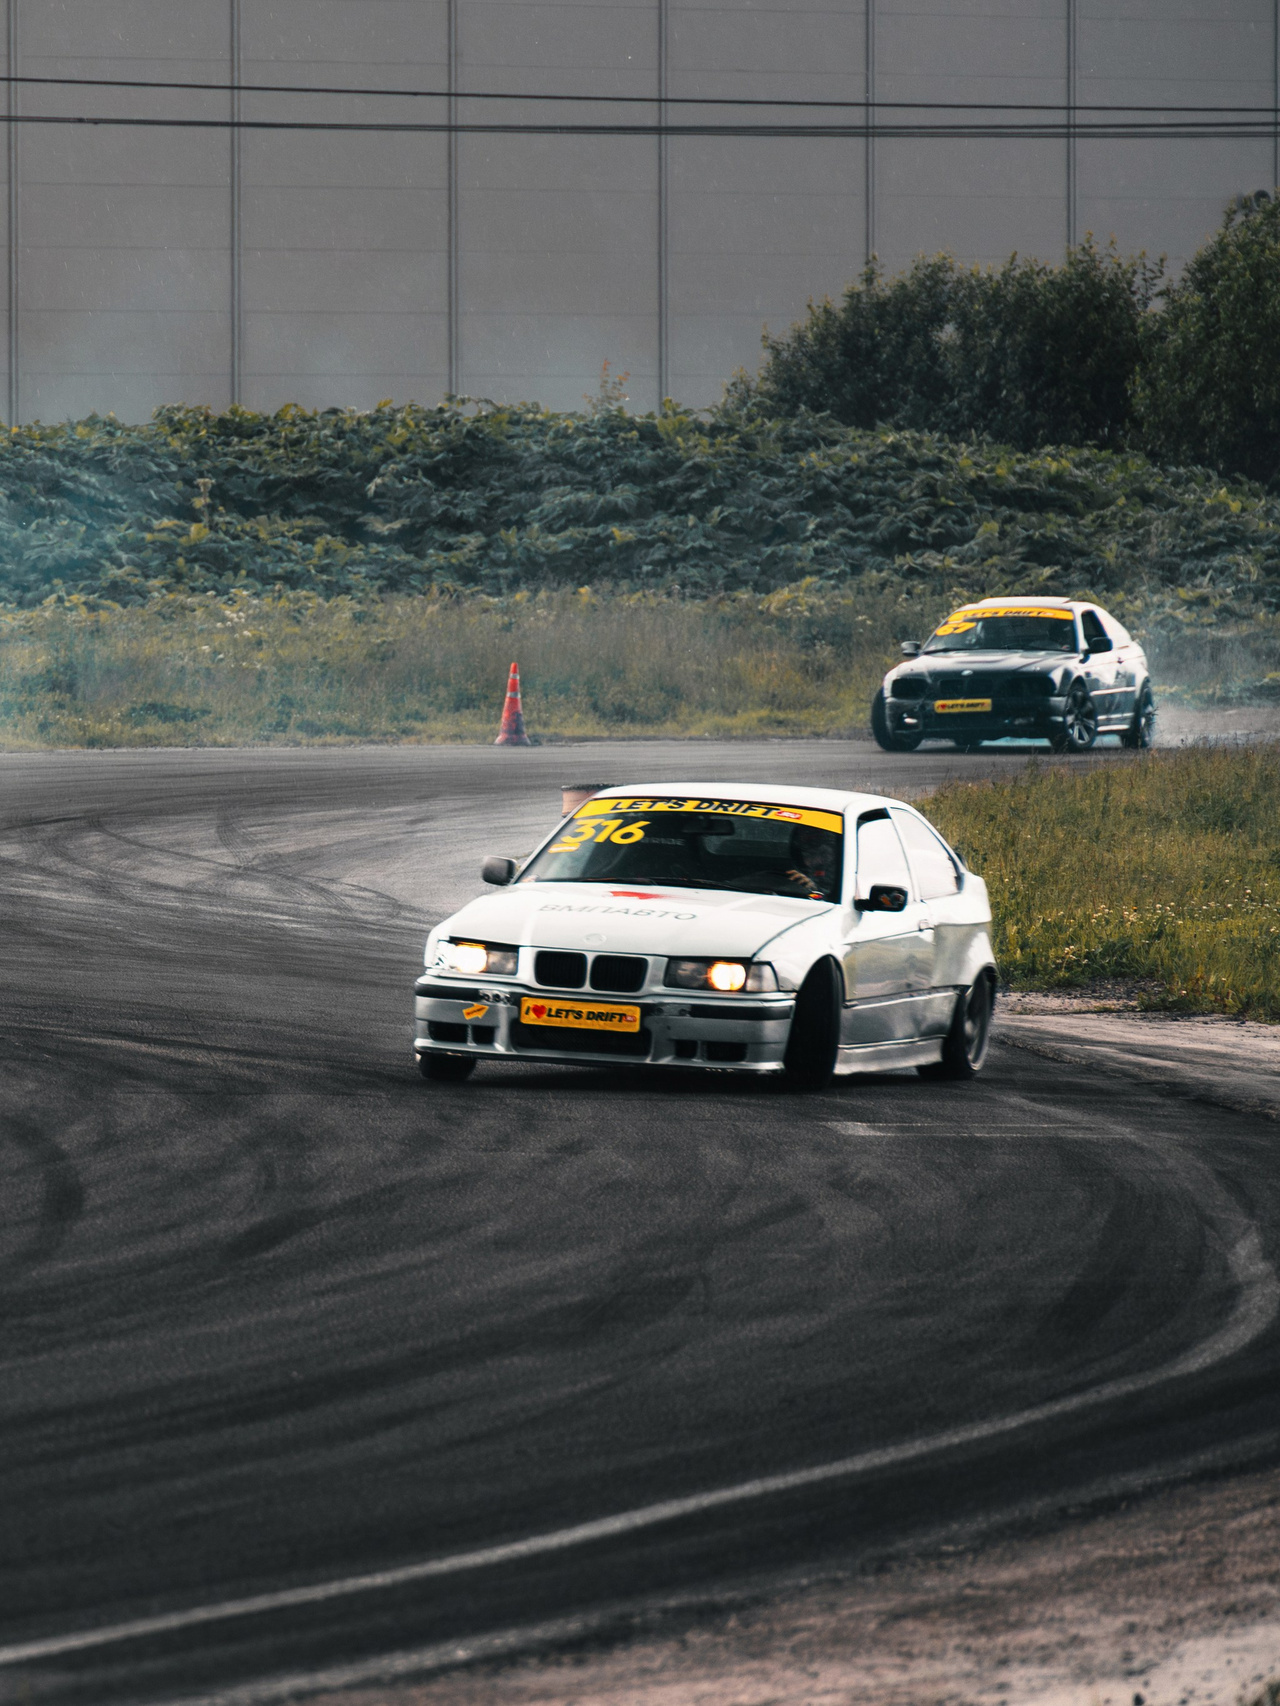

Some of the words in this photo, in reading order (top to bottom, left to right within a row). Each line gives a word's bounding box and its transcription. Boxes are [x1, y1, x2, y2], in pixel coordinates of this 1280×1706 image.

[935, 621, 977, 636] 67
[609, 799, 688, 811] LET'S
[693, 800, 783, 817] DRIFT
[561, 819, 650, 844] 316
[524, 1006, 531, 1016] I
[546, 1007, 583, 1020] LET'S
[586, 1010, 627, 1023] DRIFT
